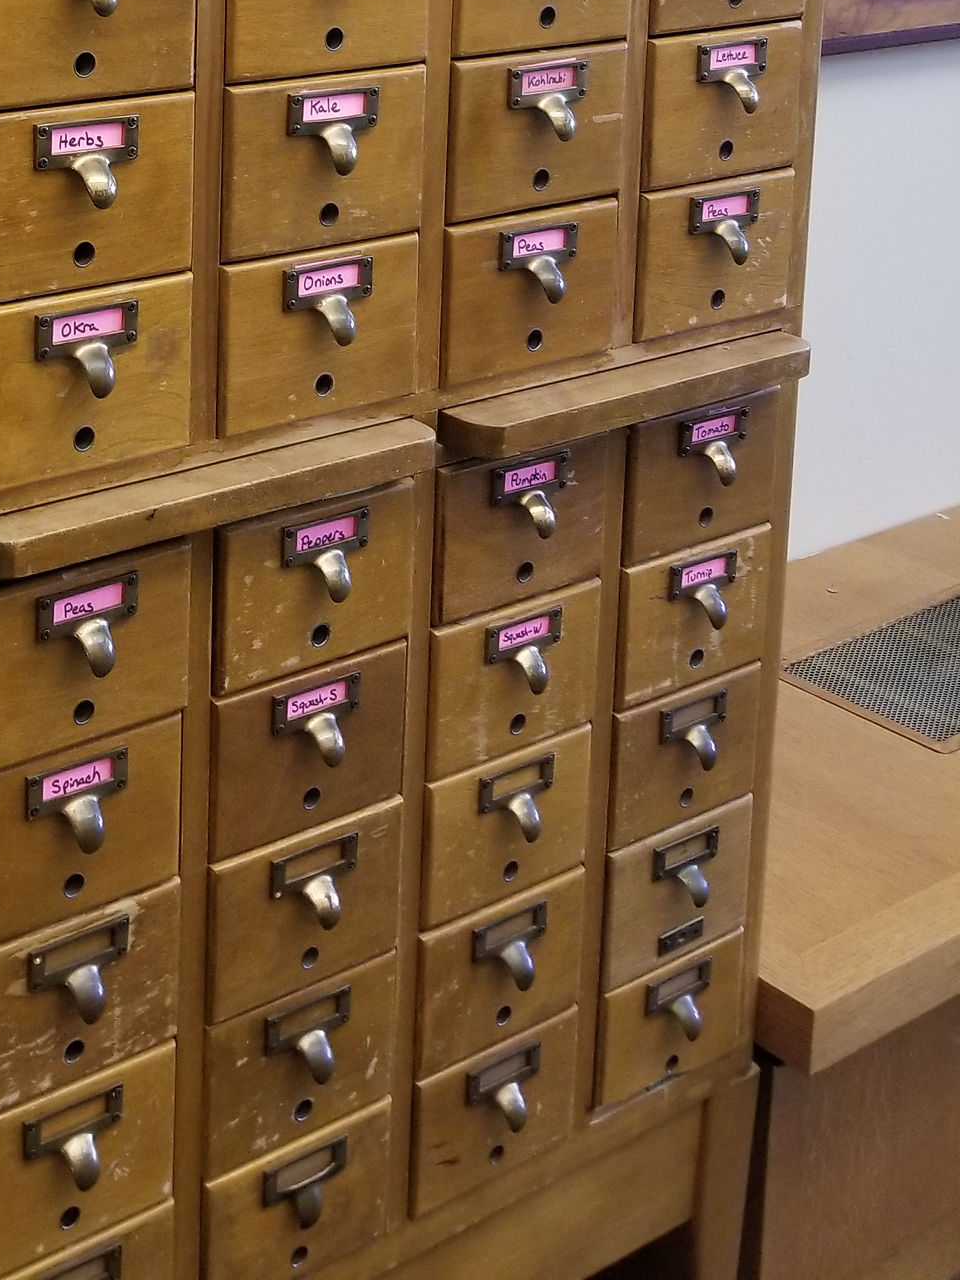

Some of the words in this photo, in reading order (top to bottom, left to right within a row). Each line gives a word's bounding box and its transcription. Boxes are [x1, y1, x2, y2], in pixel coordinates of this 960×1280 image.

[715, 49, 748, 64] Lettuce
[527, 73, 567, 89] Kohlrabi
[309, 99, 341, 116] Kale
[58, 132, 104, 149] Herbs
[707, 206, 728, 218] Peas
[517, 239, 544, 254] Peas
[303, 274, 344, 291] Onions
[61, 322, 100, 338] Okra
[695, 423, 729, 439] Tomato
[510, 469, 548, 488] Pumpkin
[684, 569, 712, 584] Turnip
[64, 602, 95, 619] Peas
[50, 766, 101, 795] Spinach
